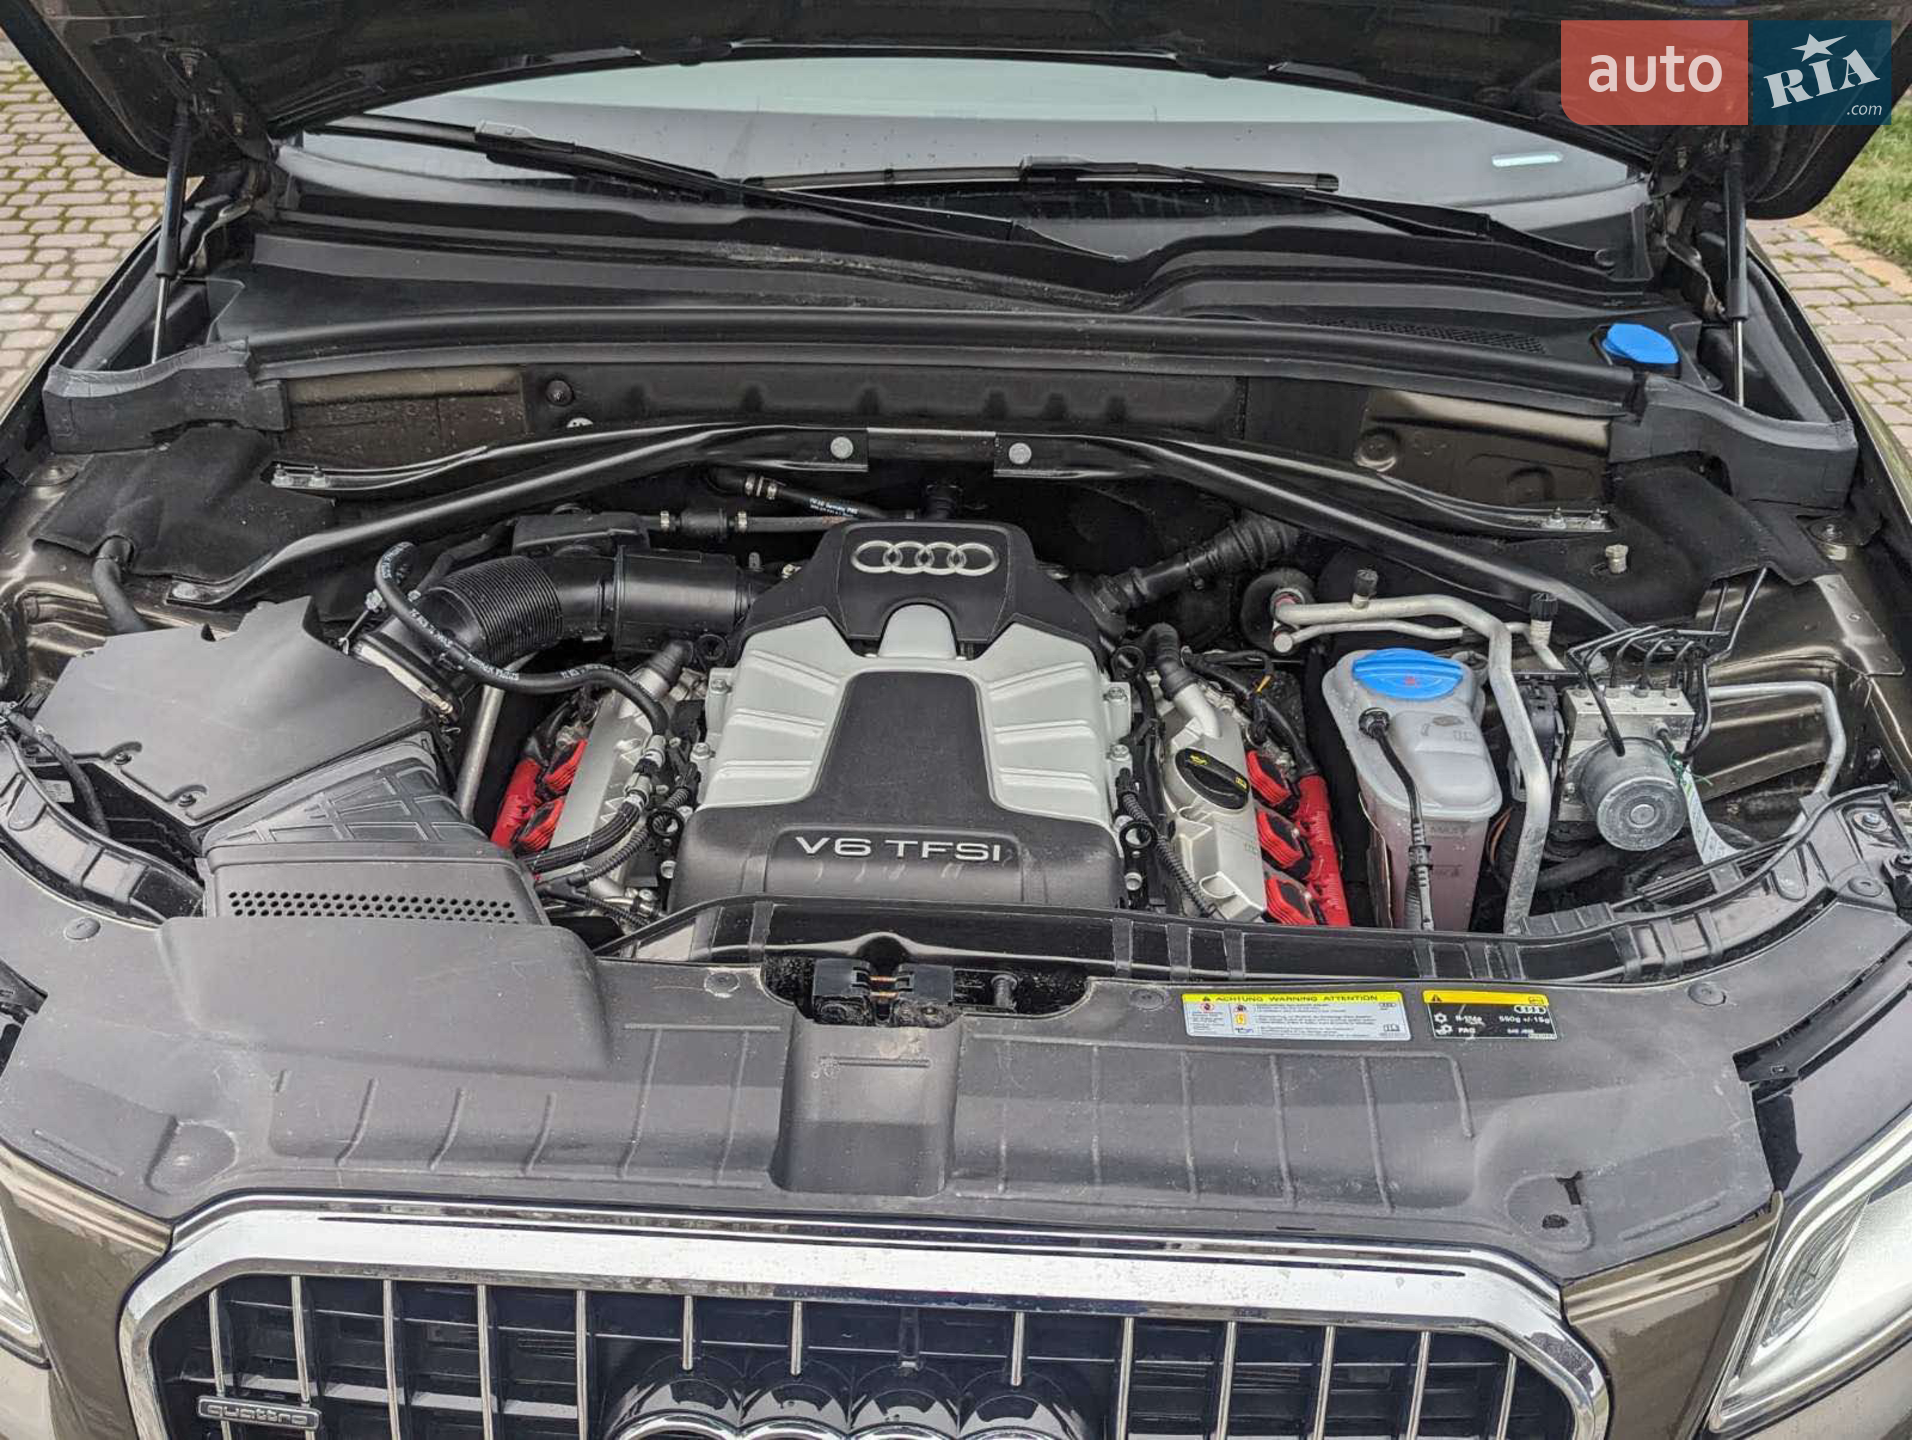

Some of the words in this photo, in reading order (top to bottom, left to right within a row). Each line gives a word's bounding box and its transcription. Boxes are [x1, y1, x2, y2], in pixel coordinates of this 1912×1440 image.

[795, 836, 872, 857] V6
[885, 839, 1001, 862] TFSI
[207, 1404, 308, 1425] quattro
